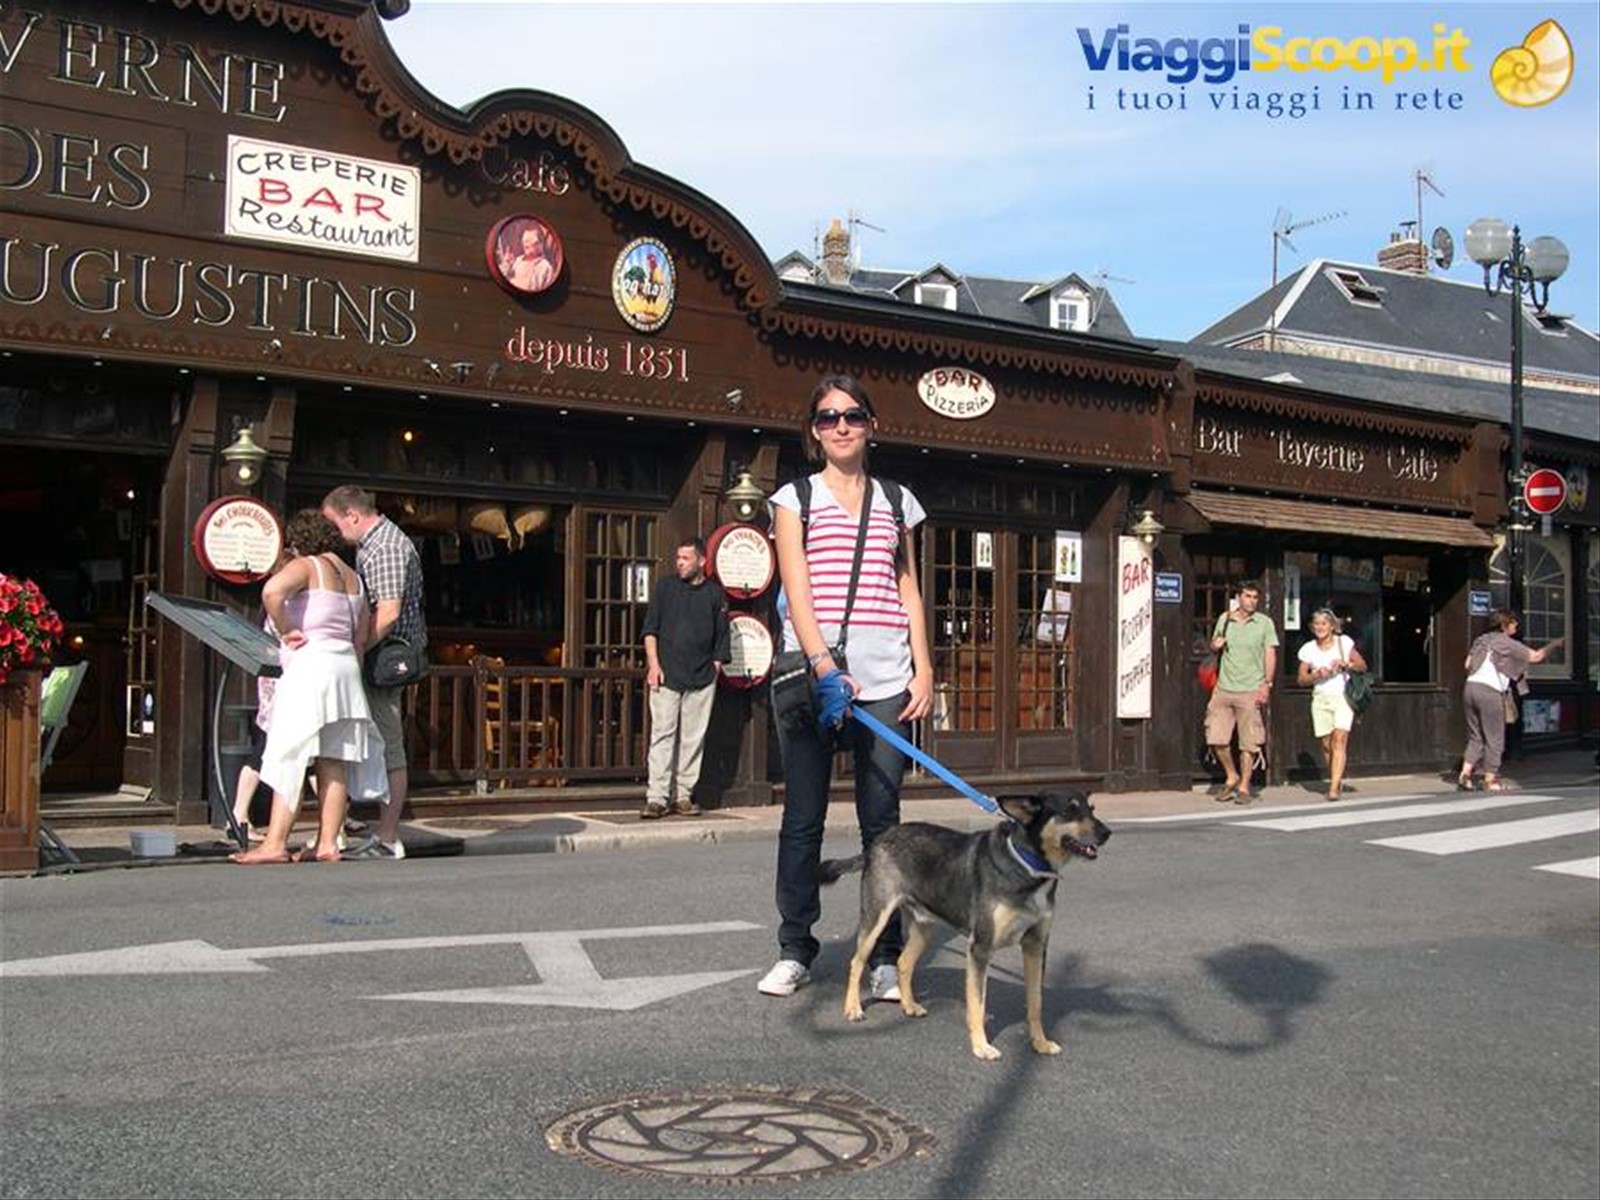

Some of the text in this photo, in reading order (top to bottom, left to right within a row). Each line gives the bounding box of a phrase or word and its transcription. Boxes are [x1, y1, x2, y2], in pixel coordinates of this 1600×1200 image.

[237, 152, 408, 197] CREPERIE
[238, 196, 414, 248] Restaurant
[258, 177, 391, 222] BAR
[505, 326, 689, 382] depuis 1851
[935, 369, 982, 392] BAR
[1196, 417, 1243, 457] Bar
[1270, 429, 1364, 473] Taverne
[1122, 557, 1151, 594] BAR
